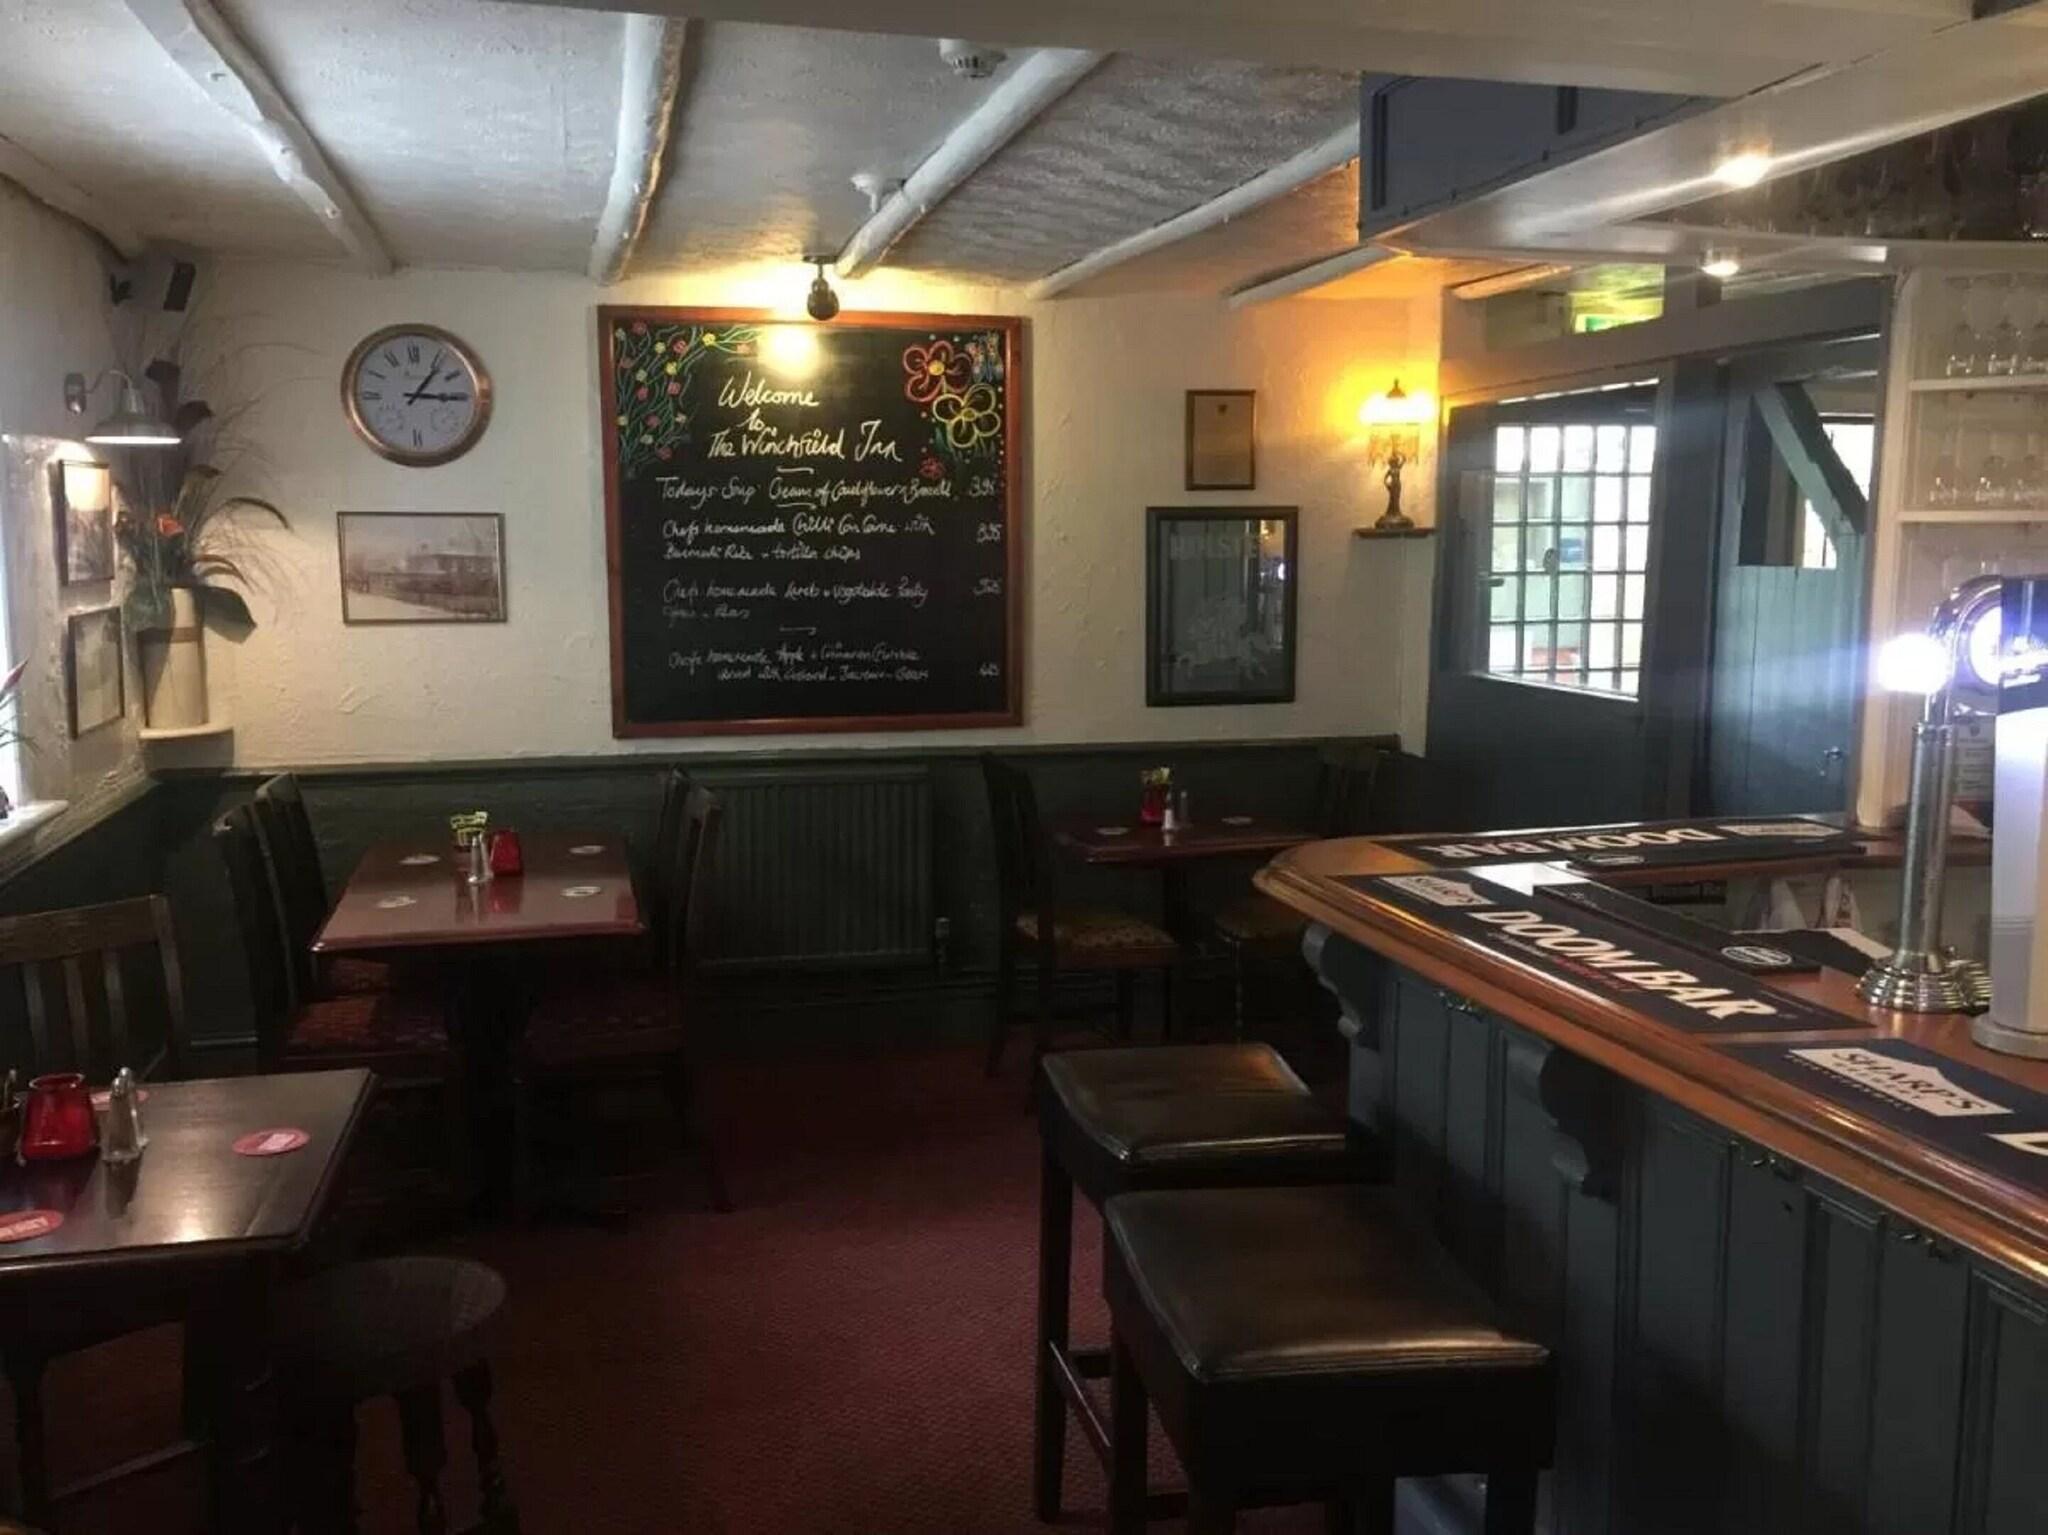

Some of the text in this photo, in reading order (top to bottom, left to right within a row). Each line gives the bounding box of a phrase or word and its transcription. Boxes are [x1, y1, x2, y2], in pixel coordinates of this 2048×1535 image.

[718, 370, 819, 408] Welcome
[708, 429, 736, 459] The
[855, 419, 902, 462] Inn
[769, 477, 811, 499] Cream
[814, 480, 829, 507] of
[1465, 911, 1662, 968] DOOM
[1613, 970, 1778, 1020] BAR
